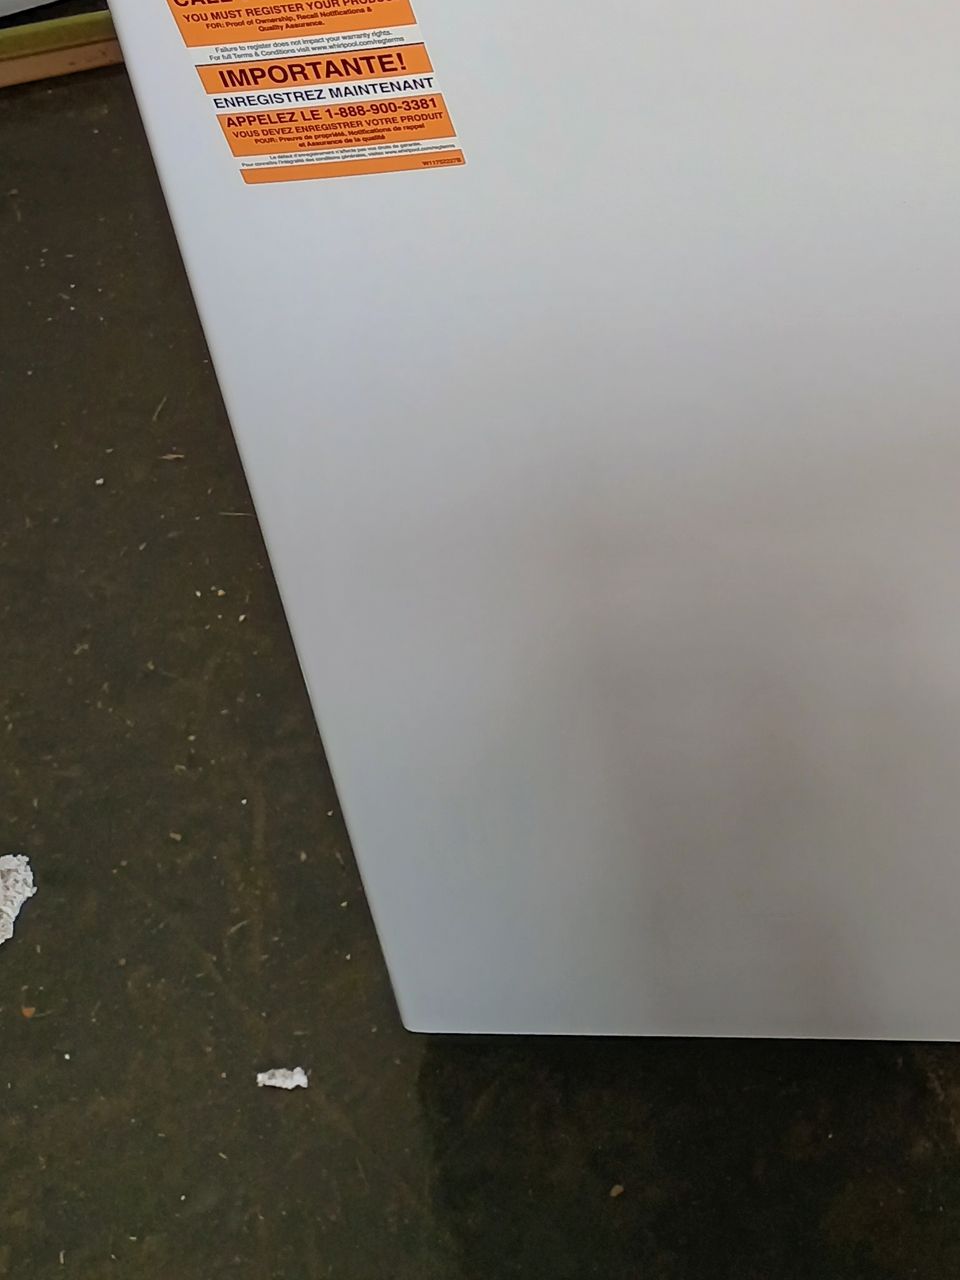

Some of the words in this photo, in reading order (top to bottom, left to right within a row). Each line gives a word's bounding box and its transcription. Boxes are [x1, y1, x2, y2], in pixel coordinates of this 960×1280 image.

[182, 13, 209, 23] YOU
[210, 9, 242, 21] MUST
[245, 3, 305, 17] REGISTER
[205, 21, 225, 30] FOR:
[226, 20, 245, 28] Proof
[297, 11, 320, 21] Recall
[258, 24, 284, 32] Quality
[215, 46, 239, 54] Failure
[247, 43, 272, 51] register
[326, 35, 341, 43] your
[233, 51, 254, 59] Terms
[261, 47, 296, 56] Conditions
[218, 52, 407, 88] IMPORTANTE!
[213, 89, 324, 109] ENREGISTREZ
[328, 77, 434, 99] MAINTENANT
[226, 111, 299, 128] APPELEZ
[300, 109, 323, 122] LE
[325, 97, 438, 120] 1-888-900-3381
[232, 129, 260, 138] VOUS
[261, 126, 293, 136] DEVEZ
[295, 120, 364, 134] ENREGISTRER
[365, 116, 399, 127] VOTRE
[400, 111, 444, 123] PRODUIT
